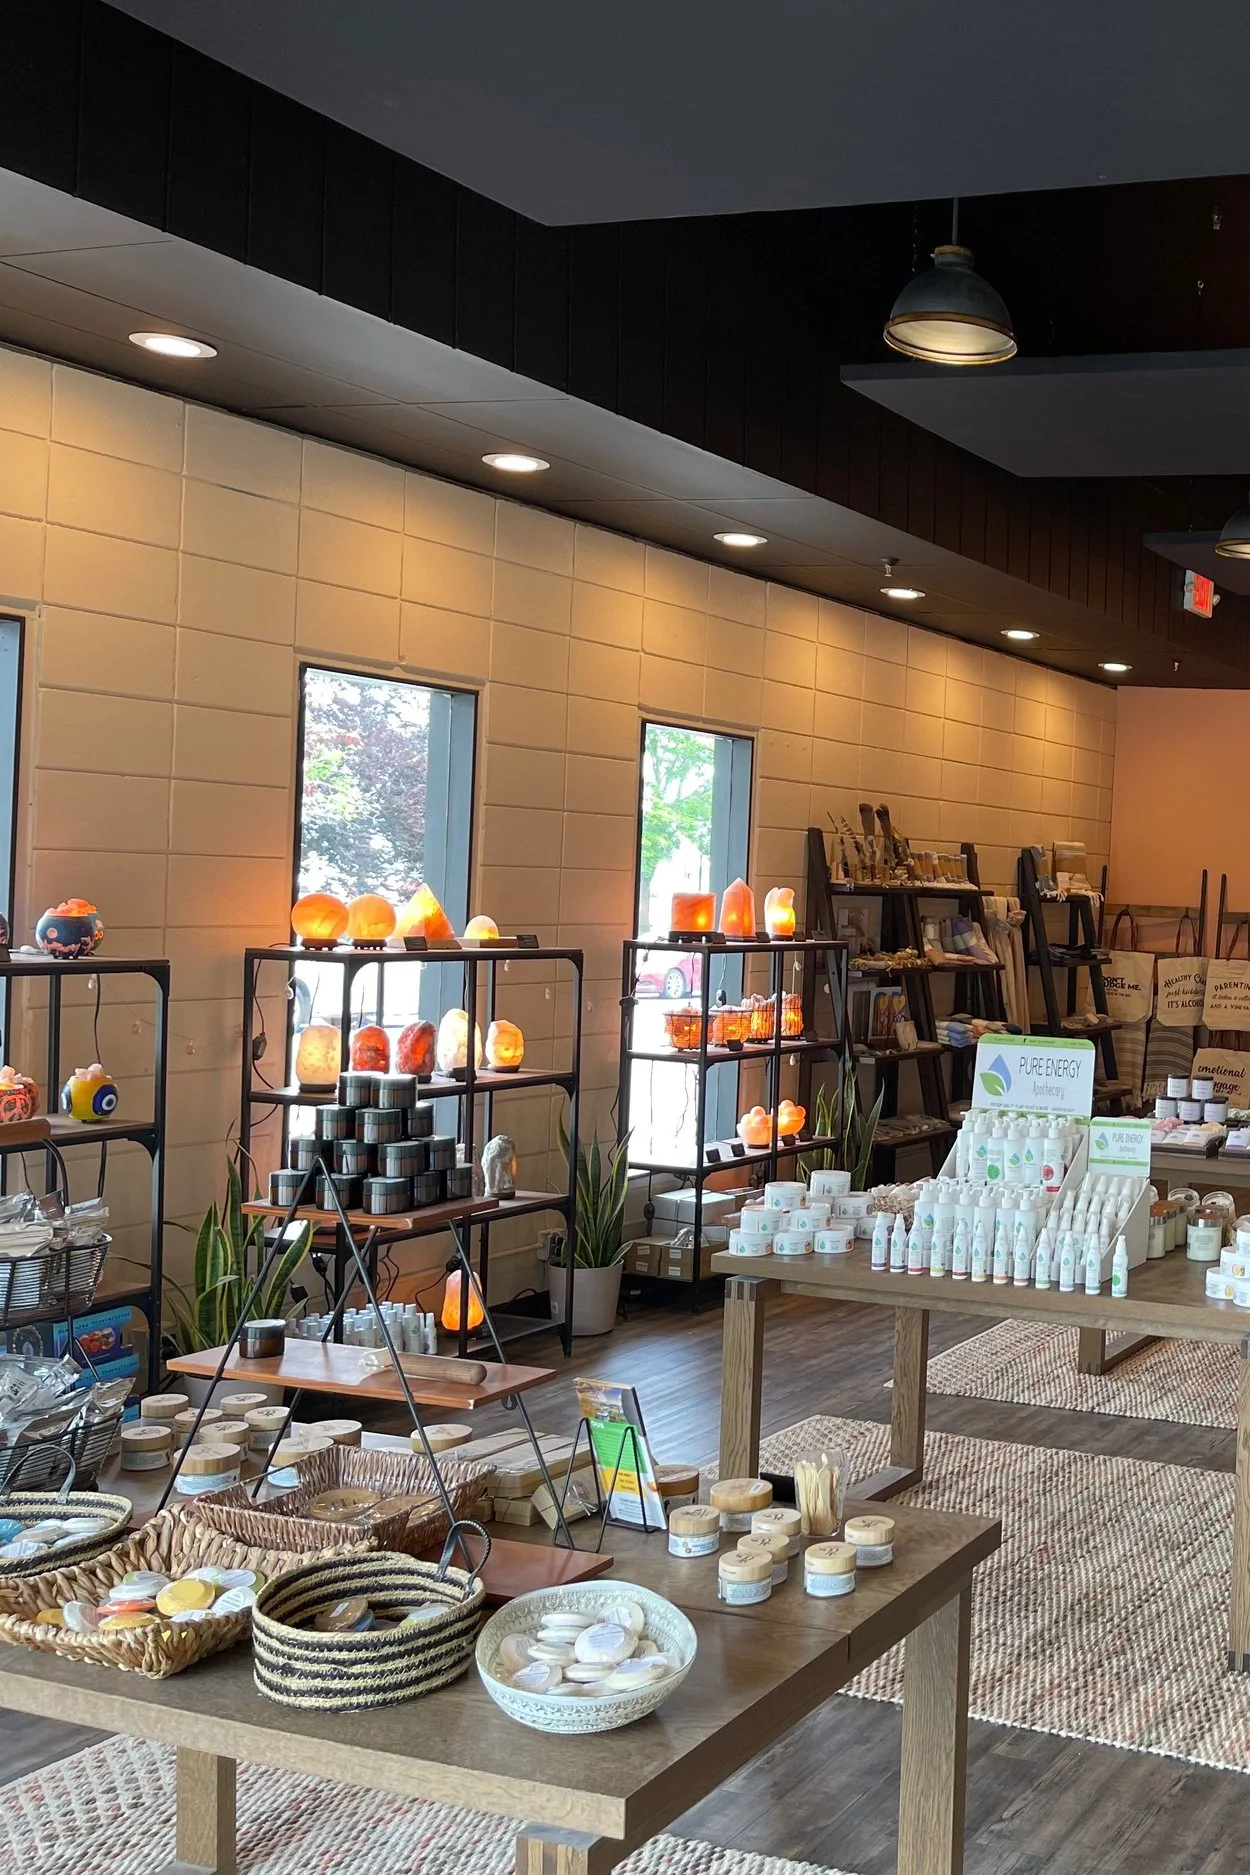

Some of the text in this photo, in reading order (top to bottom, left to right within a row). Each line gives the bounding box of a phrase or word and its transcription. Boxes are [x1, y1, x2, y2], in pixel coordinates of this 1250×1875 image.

[1103, 981, 1126, 989] UDGE
[1181, 999, 1205, 1008] ALCOHO
[1019, 1056, 1082, 1078] PURE ENERGY
[1197, 1065, 1246, 1078] emotional
[1031, 1080, 1066, 1100] Apothecary
[1212, 1081, 1242, 1096] ggage
